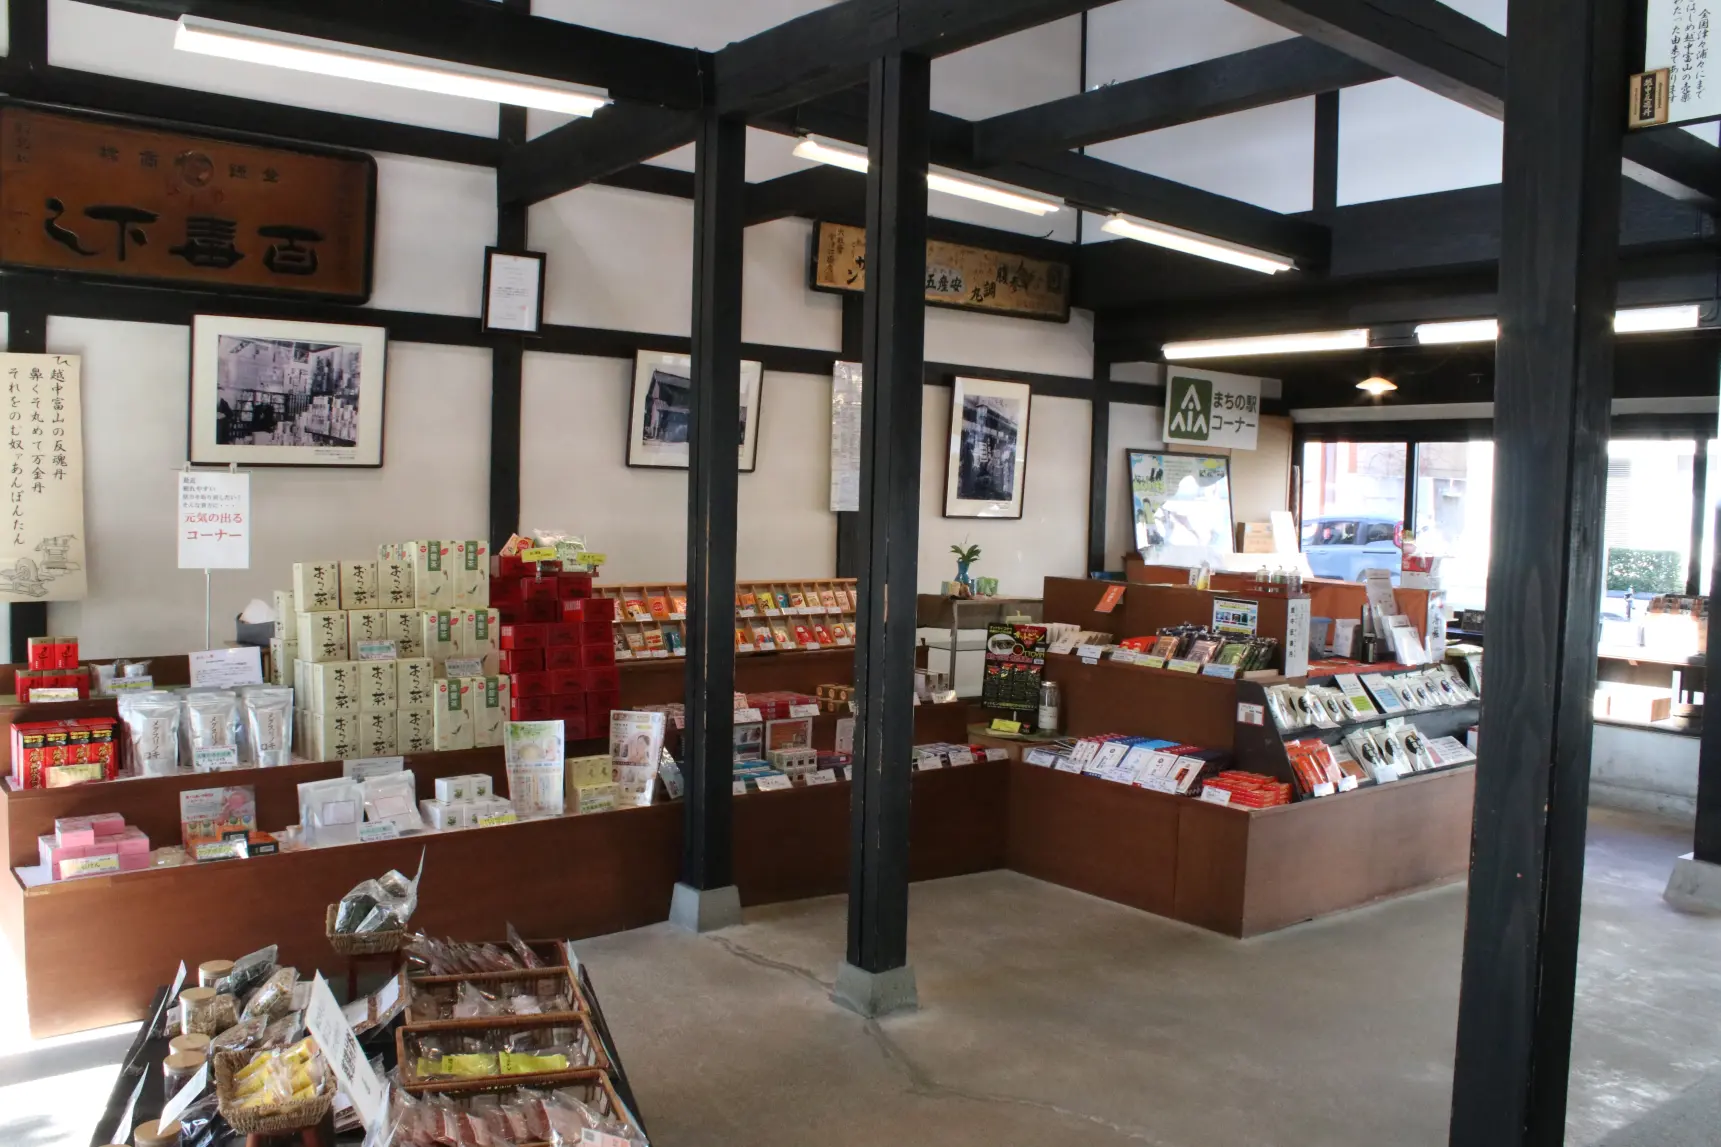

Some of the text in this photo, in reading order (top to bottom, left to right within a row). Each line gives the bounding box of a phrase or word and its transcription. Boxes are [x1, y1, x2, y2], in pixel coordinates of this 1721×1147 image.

[1213, 391, 1257, 414] まちの駅
[29, 367, 46, 494] 鼻くそ丸めて万金丹
[50, 368, 68, 481] 越中富山の反魂丹
[1211, 414, 1256, 433] コーナー
[184, 512, 243, 524] 元気の出る
[187, 528, 242, 542] コーナー
